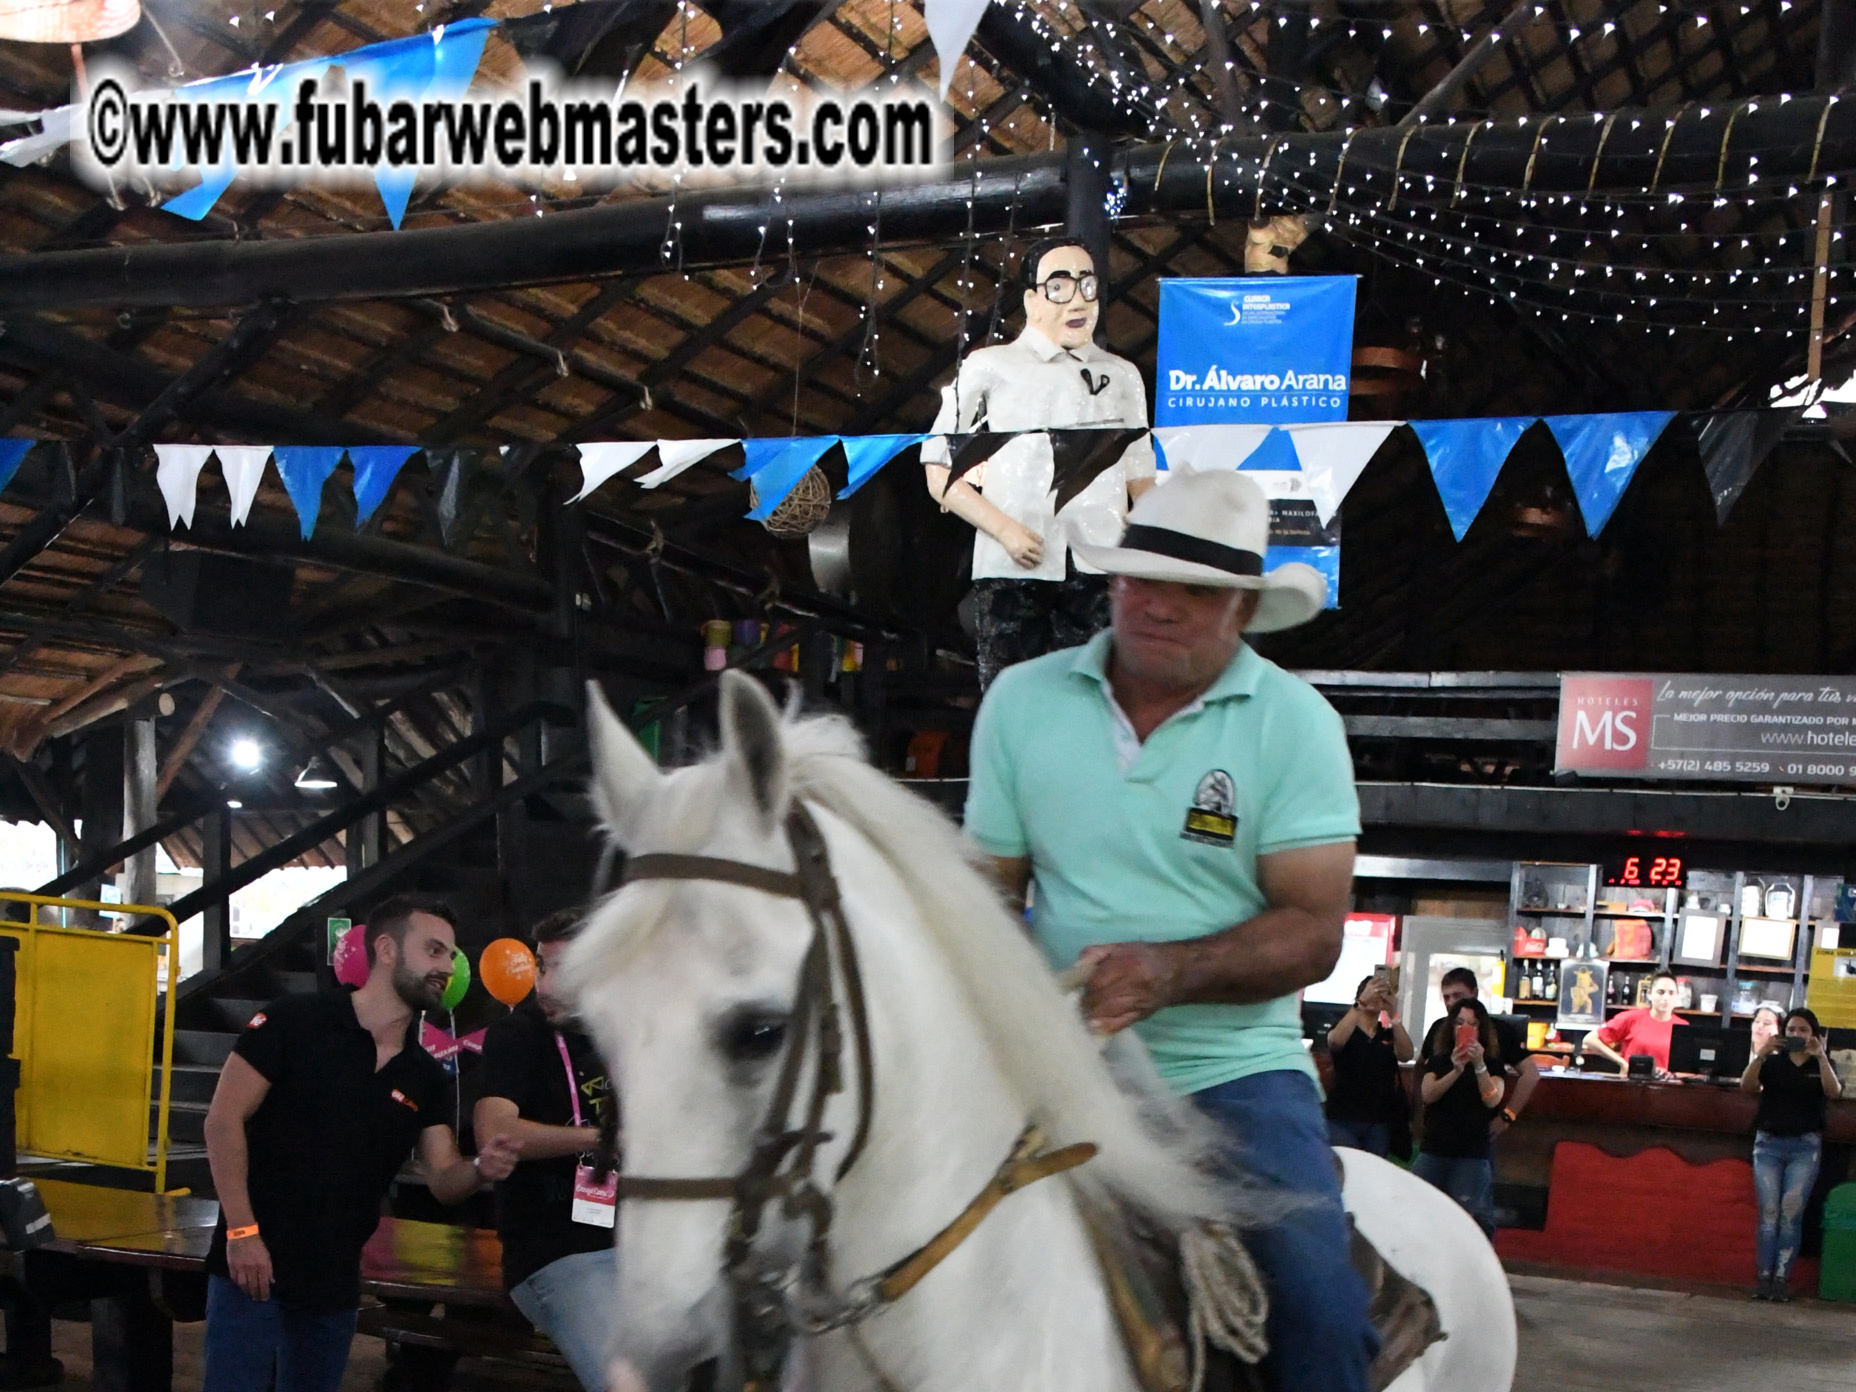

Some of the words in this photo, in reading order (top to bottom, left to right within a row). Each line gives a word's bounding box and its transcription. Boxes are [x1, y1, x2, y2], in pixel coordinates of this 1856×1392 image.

[1169, 370, 1200, 390] Dr.
[1202, 365, 1280, 390] Álvaro
[1281, 370, 1347, 390] Arana
[1168, 397, 1250, 407] CIRUJANO
[1261, 395, 1341, 407] PLÁSTICO
[1577, 696, 1639, 706] HOTELES
[1657, 680, 1675, 701] La
[1678, 686, 1723, 707] mejor
[1725, 688, 1775, 708] opción
[1774, 692, 1814, 709] para
[1674, 713, 1707, 722] MEJOR
[1710, 714, 1748, 722] PRECIO
[1750, 715, 1824, 725] GARANTIZADO
[1826, 716, 1850, 726] POR
[1572, 710, 1637, 751] MS
[1658, 760, 1700, 772] +57(2)
[1705, 761, 1731, 772] 485
[1735, 762, 1770, 773] 5259
[1787, 763, 1803, 774] 01
[1807, 764, 1845, 776] 8000
[1624, 857, 1639, 879] 6
[1649, 857, 1681, 880] 23
